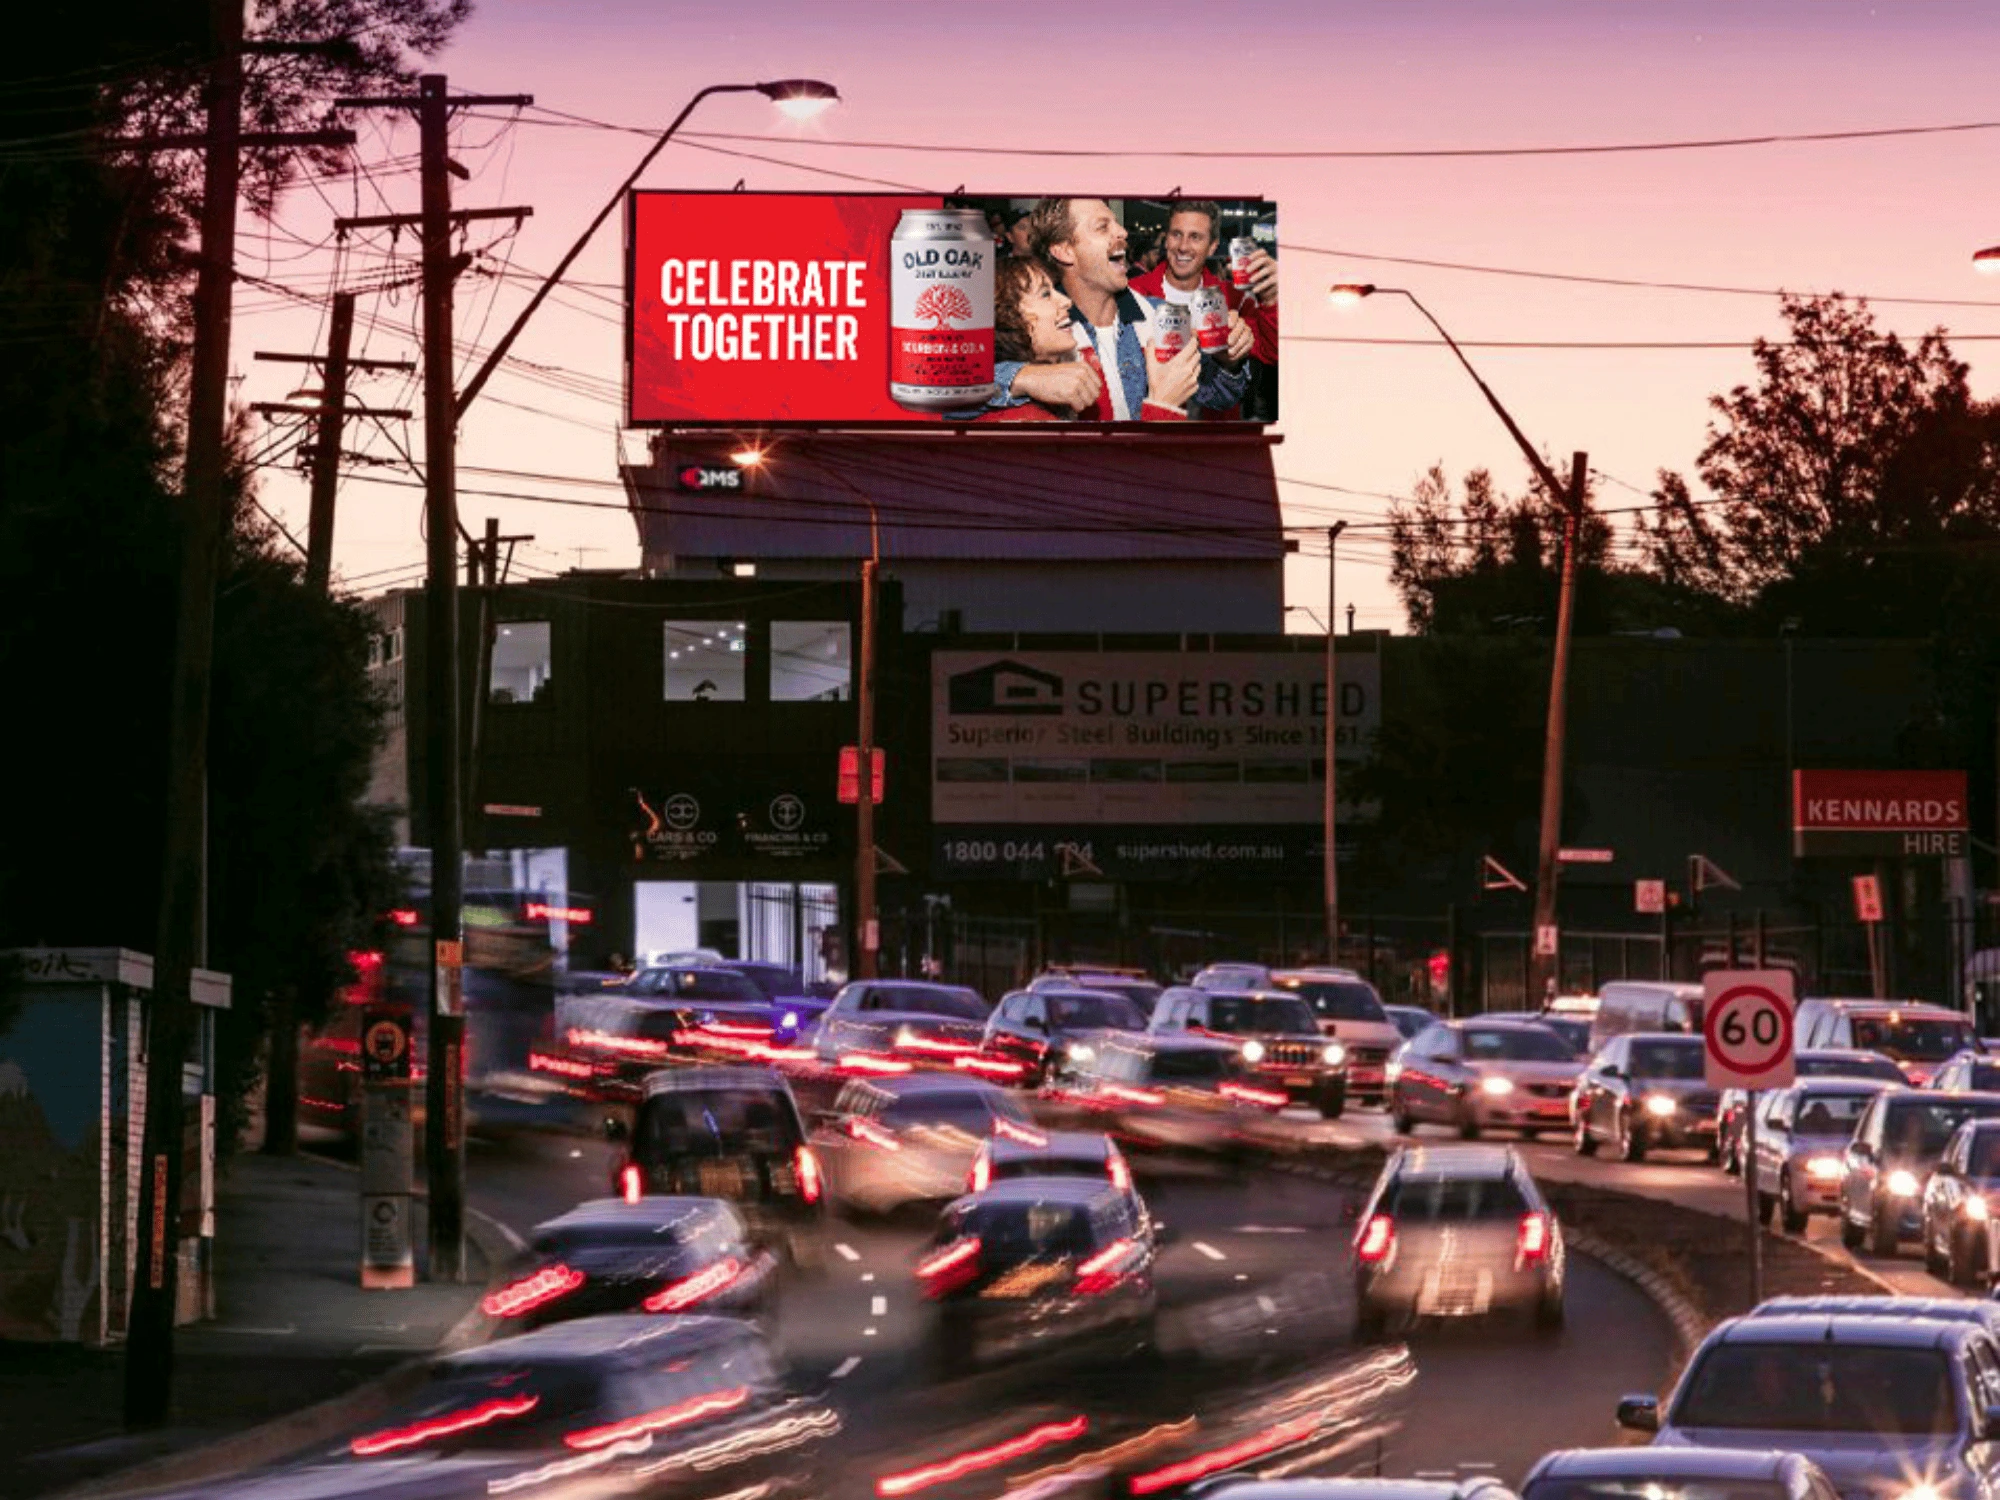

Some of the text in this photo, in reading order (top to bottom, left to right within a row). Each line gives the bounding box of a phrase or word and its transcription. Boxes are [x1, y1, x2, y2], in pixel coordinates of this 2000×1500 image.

[903, 249, 984, 270] OLD OAK
[660, 258, 867, 307] CELEBRATE
[667, 313, 858, 361] TOGETHER
[1077, 680, 1366, 716] SUPERSHED
[948, 723, 1046, 748] Superior
[1056, 723, 1114, 746] Steel
[1126, 724, 1234, 749] Buildings
[1244, 724, 1303, 746] Since
[1807, 798, 1961, 823] KENNARDS
[943, 841, 997, 862] 1800
[1003, 841, 1044, 862] 044
[1116, 841, 1285, 861] supershed.com.au
[1903, 833, 1961, 855] HIRE
[1720, 1008, 1780, 1046] 60
